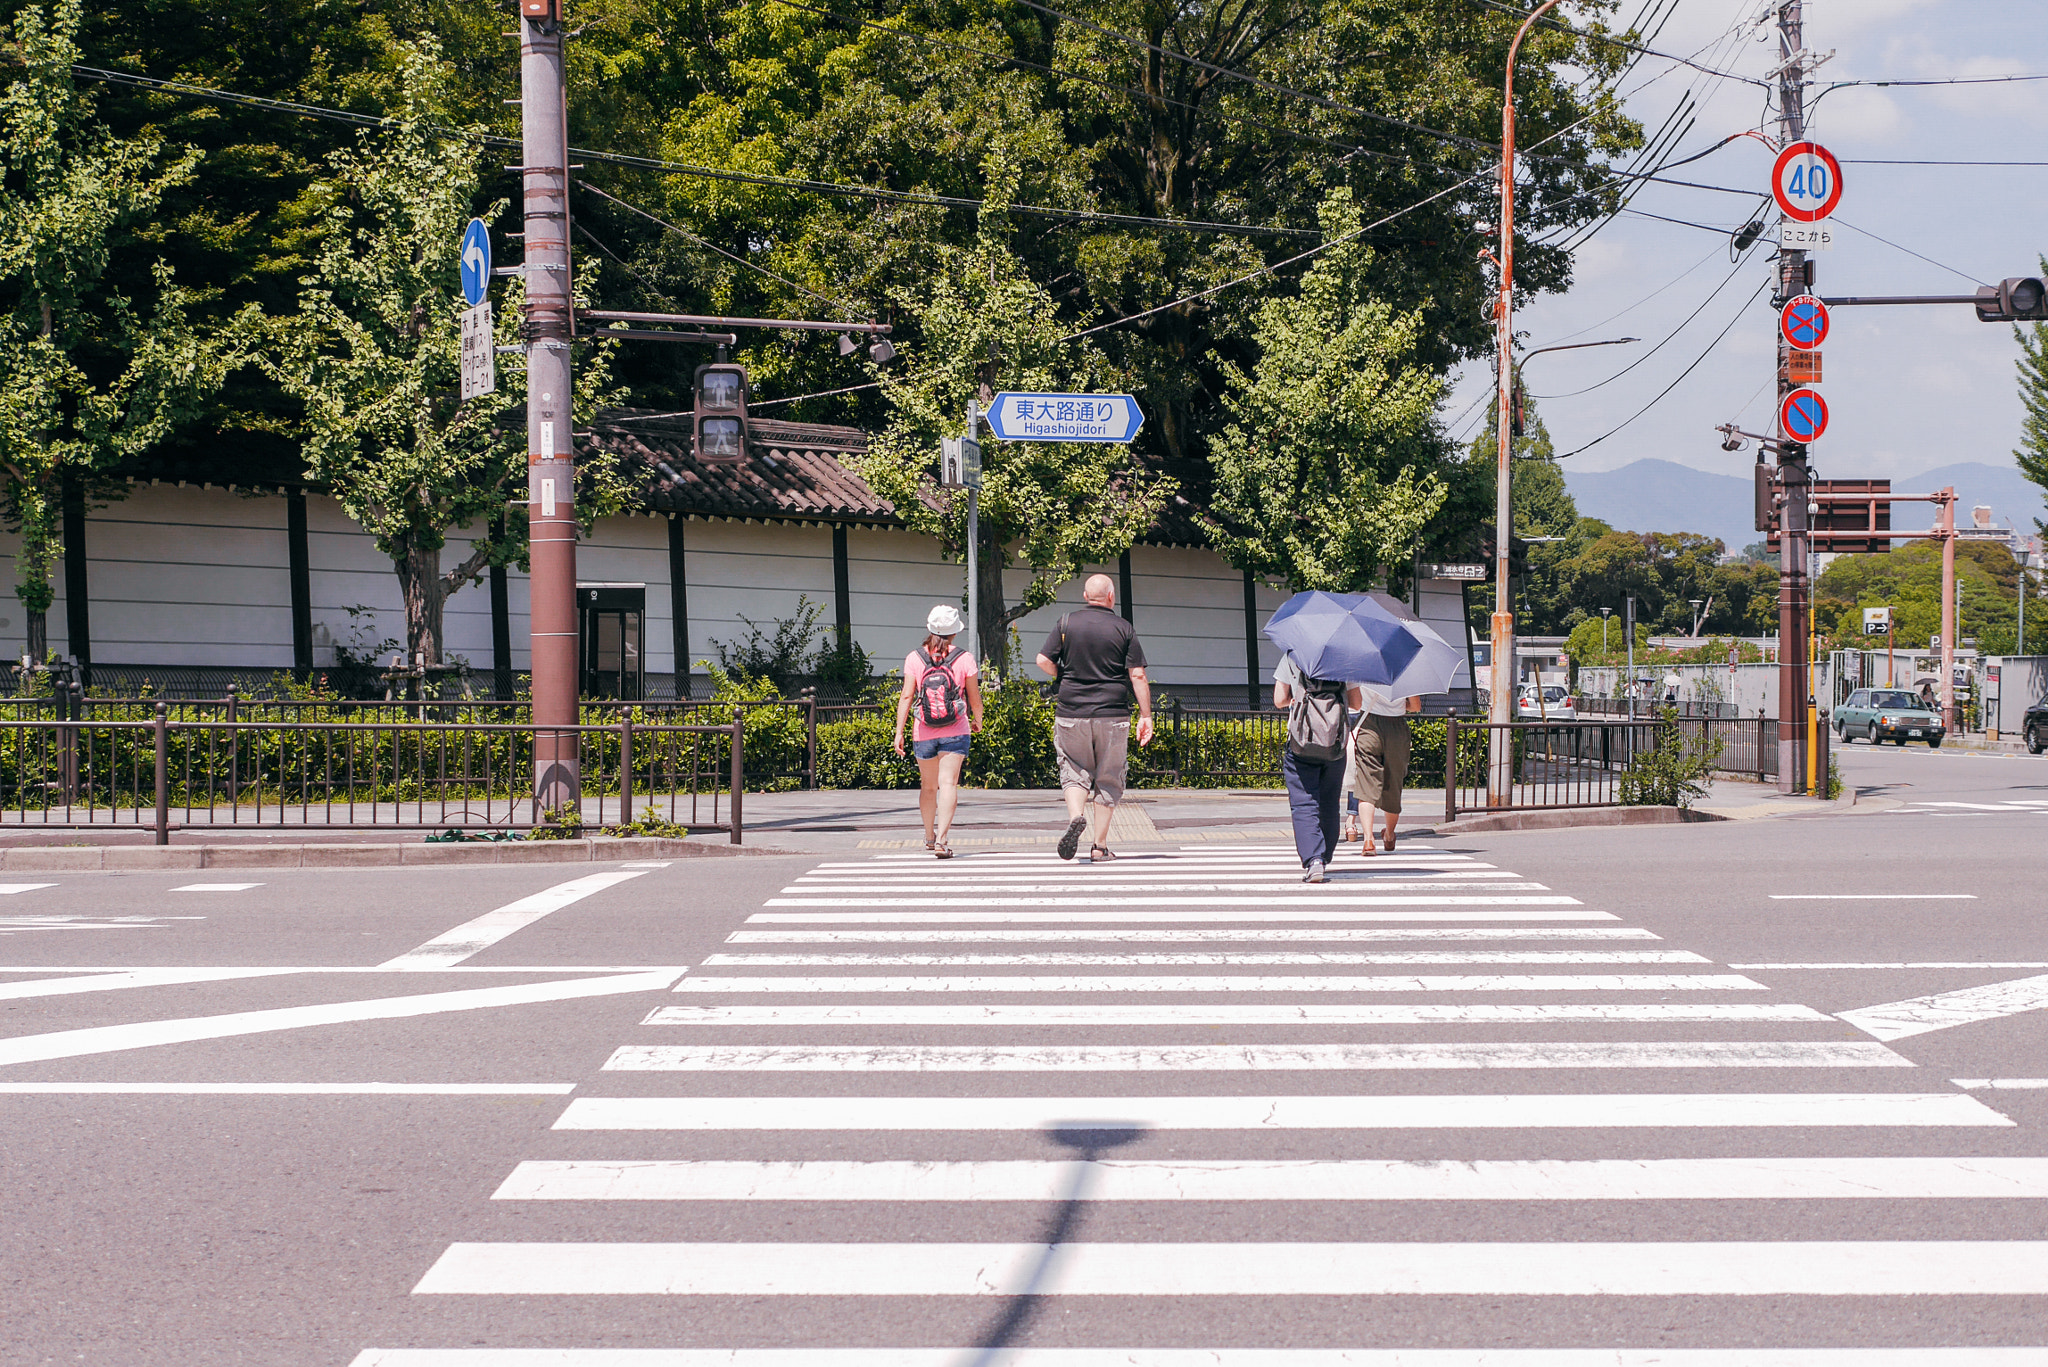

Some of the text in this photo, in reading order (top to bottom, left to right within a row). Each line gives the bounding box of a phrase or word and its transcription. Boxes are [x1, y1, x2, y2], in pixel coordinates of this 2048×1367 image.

[1788, 164, 1826, 199] 40
[1784, 230, 1831, 242] ここから
[1015, 400, 1113, 422] 東大路通り
[1024, 422, 1106, 436] Higashiojidori
[1868, 624, 1875, 634] P
[1931, 636, 1940, 647] P
